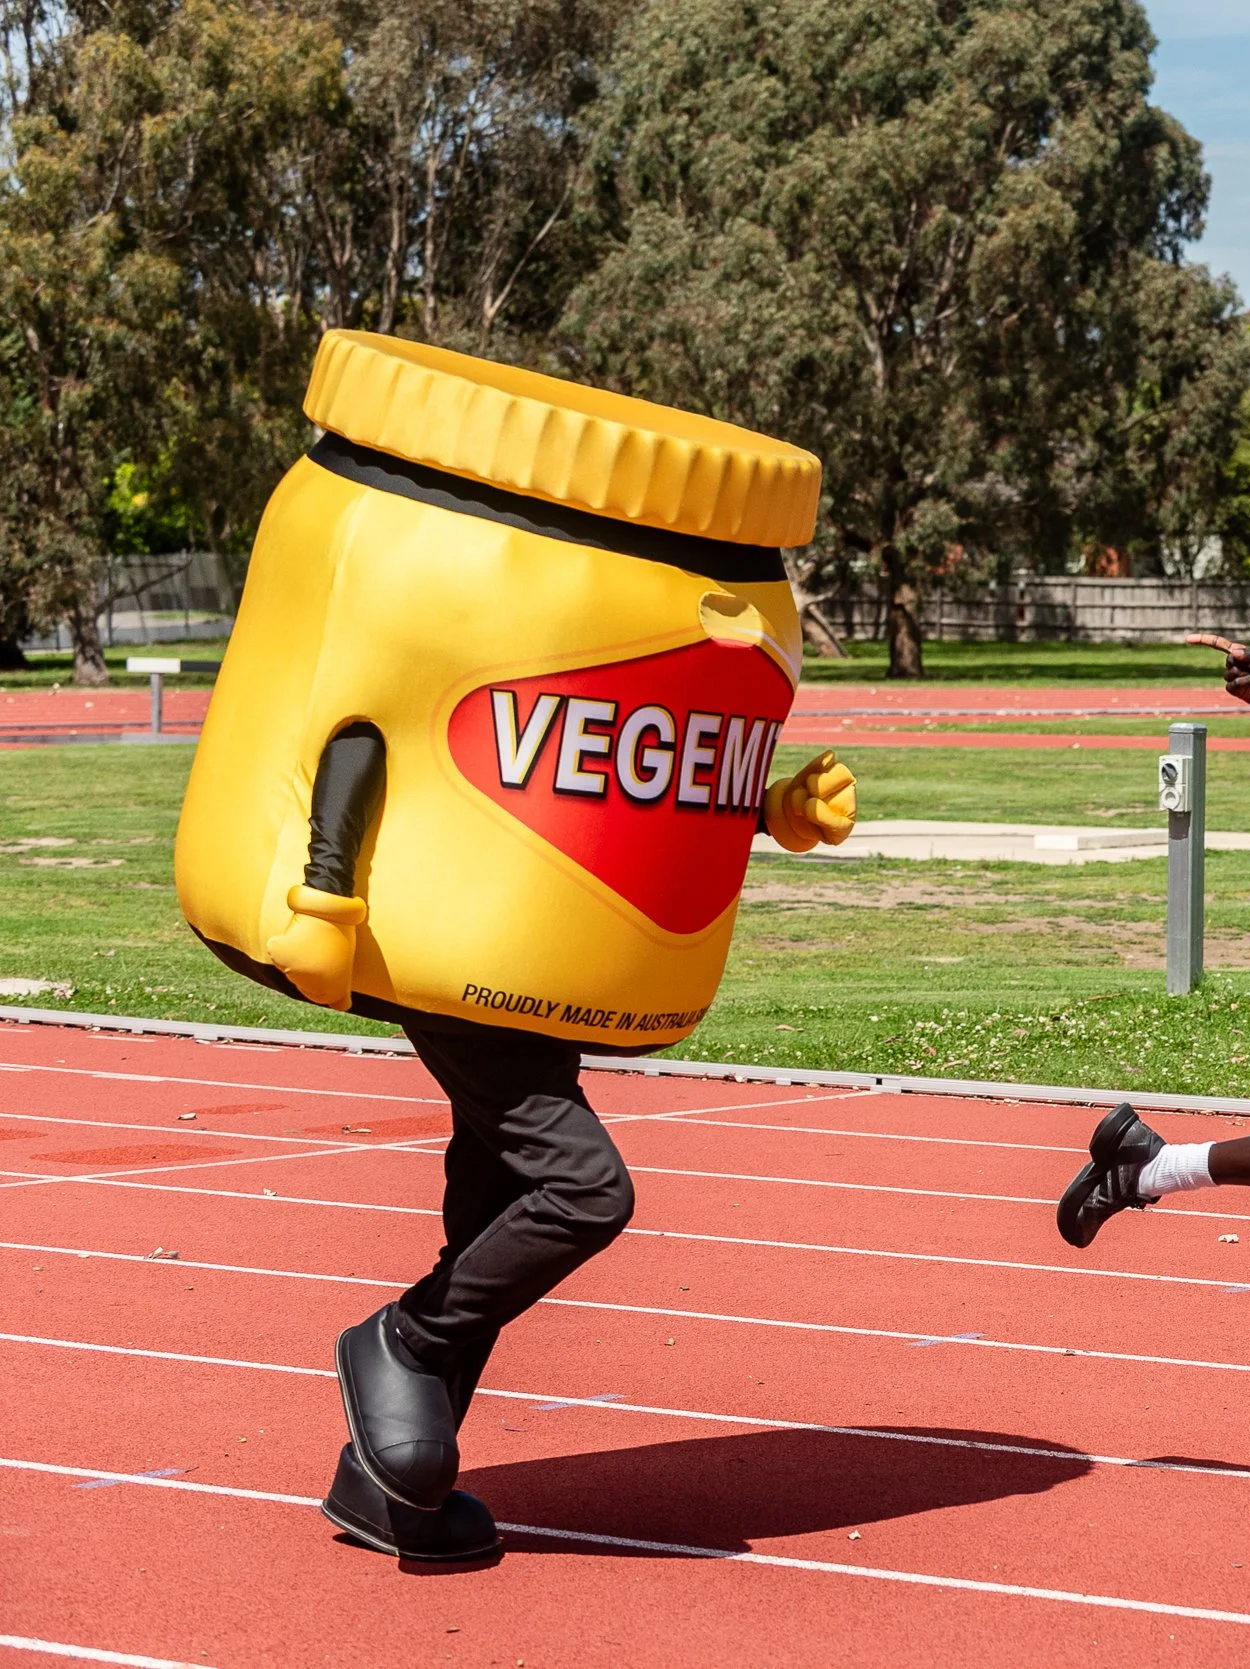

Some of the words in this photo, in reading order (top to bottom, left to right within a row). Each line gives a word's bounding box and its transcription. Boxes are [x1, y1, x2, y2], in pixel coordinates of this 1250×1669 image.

[461, 983, 561, 1019] PROUDLY
[560, 1004, 617, 1029] MADE
[615, 1012, 635, 1031] IN
